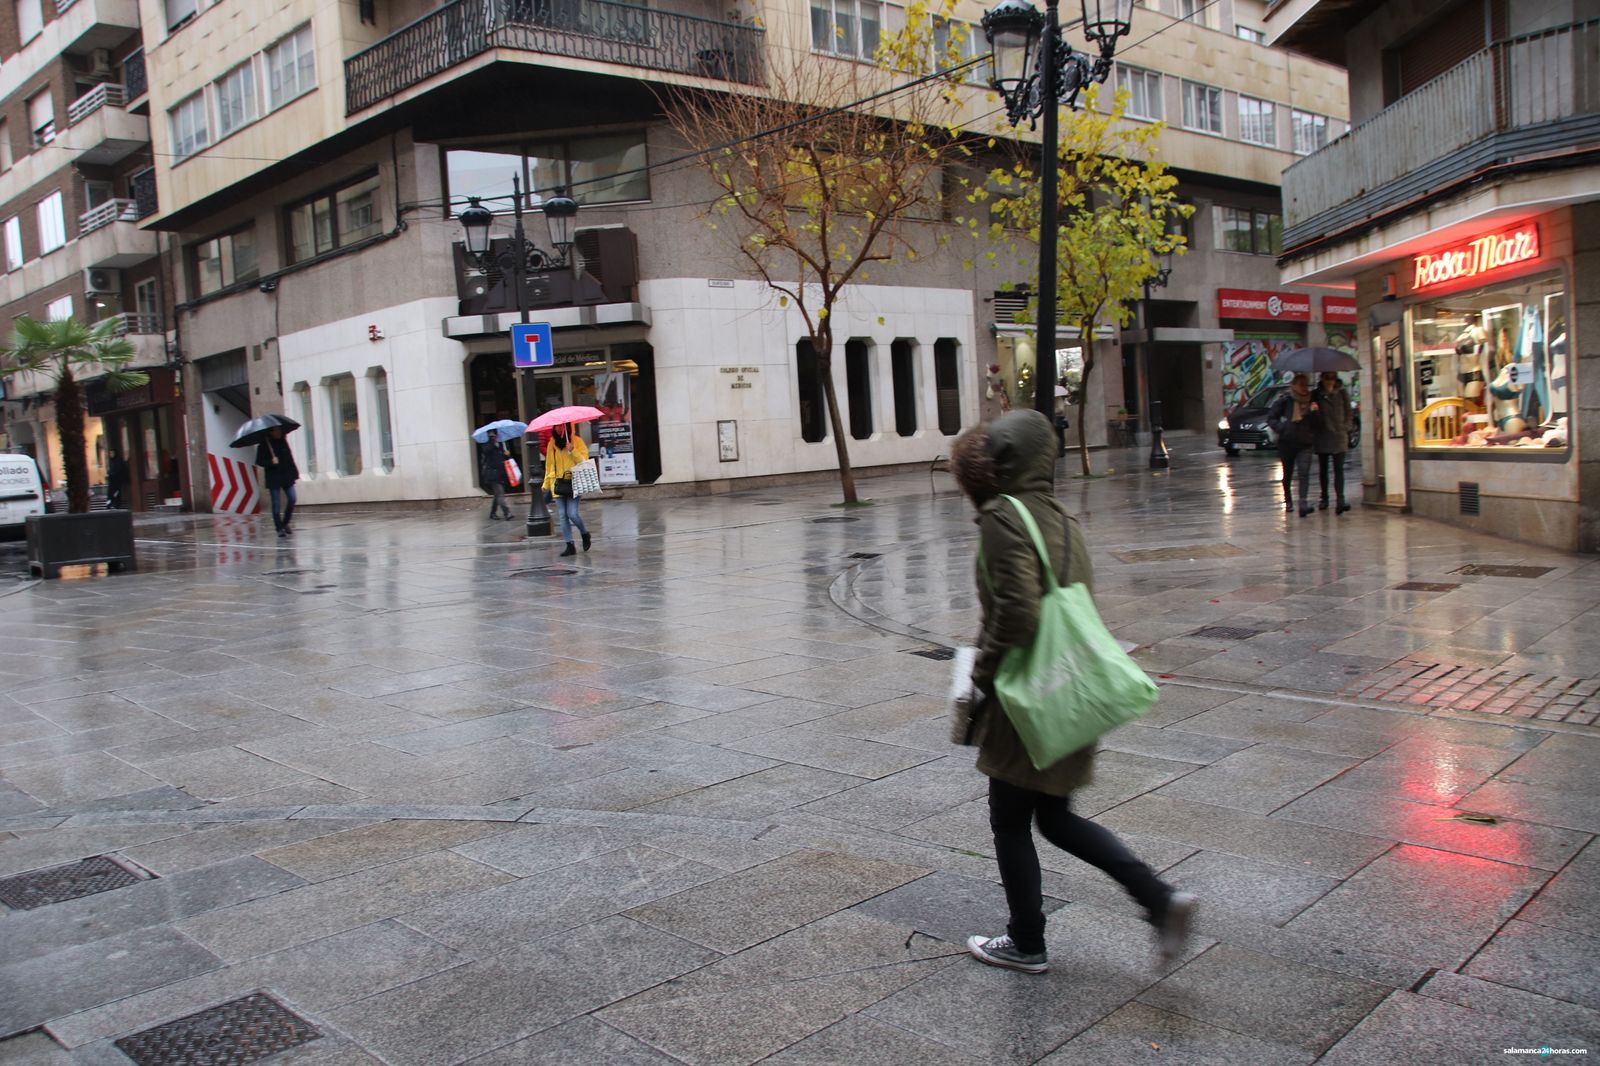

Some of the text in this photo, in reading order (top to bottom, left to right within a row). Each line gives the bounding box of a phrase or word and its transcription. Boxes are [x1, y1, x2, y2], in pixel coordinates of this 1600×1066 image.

[1411, 231, 1536, 290] Rosa Mar
[1222, 298, 1267, 309] ENTERTAINMENT
[1282, 302, 1309, 312] EXCHANGE
